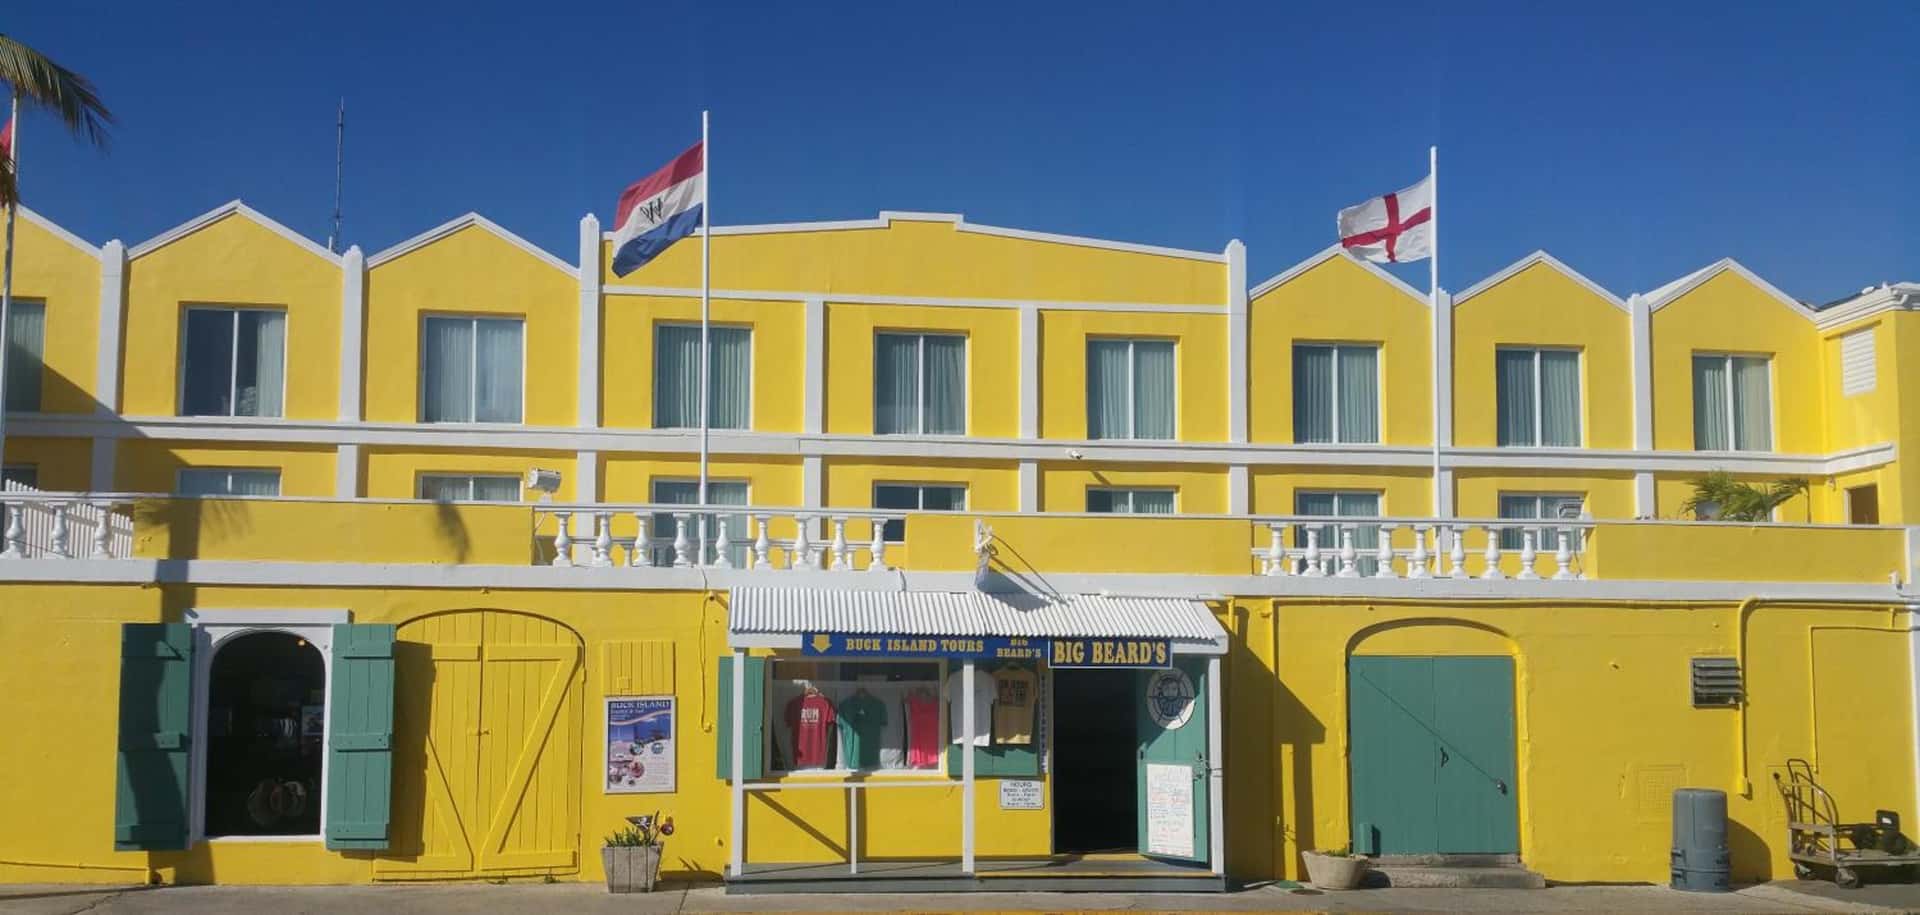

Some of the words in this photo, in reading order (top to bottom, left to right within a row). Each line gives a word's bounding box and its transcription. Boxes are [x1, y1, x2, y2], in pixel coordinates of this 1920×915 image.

[846, 639, 881, 650] BUCK
[887, 639, 937, 652] ISLAND
[941, 640, 984, 653] TOURS
[1011, 638, 1028, 646] BIG
[996, 648, 1042, 658] BEARD'S
[1054, 641, 1085, 663] BIG
[1092, 641, 1167, 664] BEARD'S
